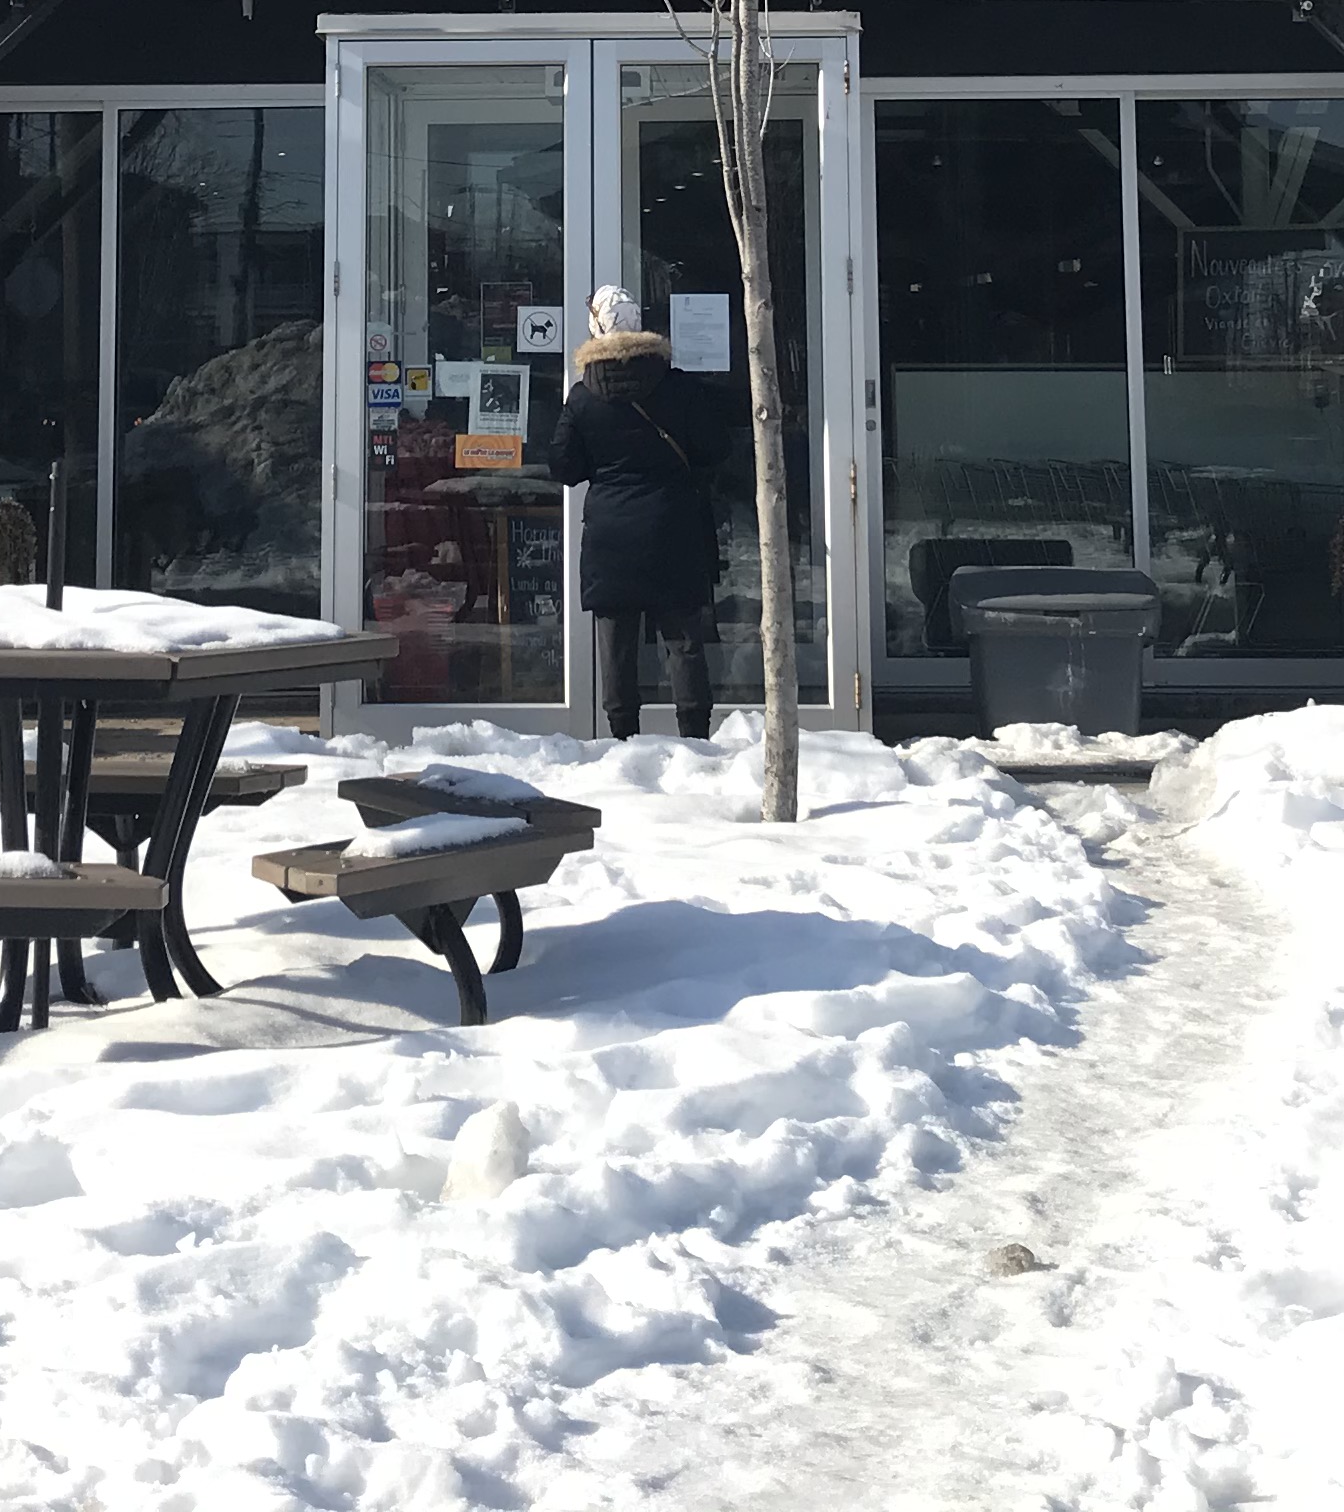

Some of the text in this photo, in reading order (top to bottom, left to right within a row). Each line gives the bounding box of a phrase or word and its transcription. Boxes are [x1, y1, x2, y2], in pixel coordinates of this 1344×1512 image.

[372, 388, 400, 399] VISA
[373, 435, 394, 445] MTL
[374, 445, 388, 456] Wi
[386, 455, 395, 466] Fi
